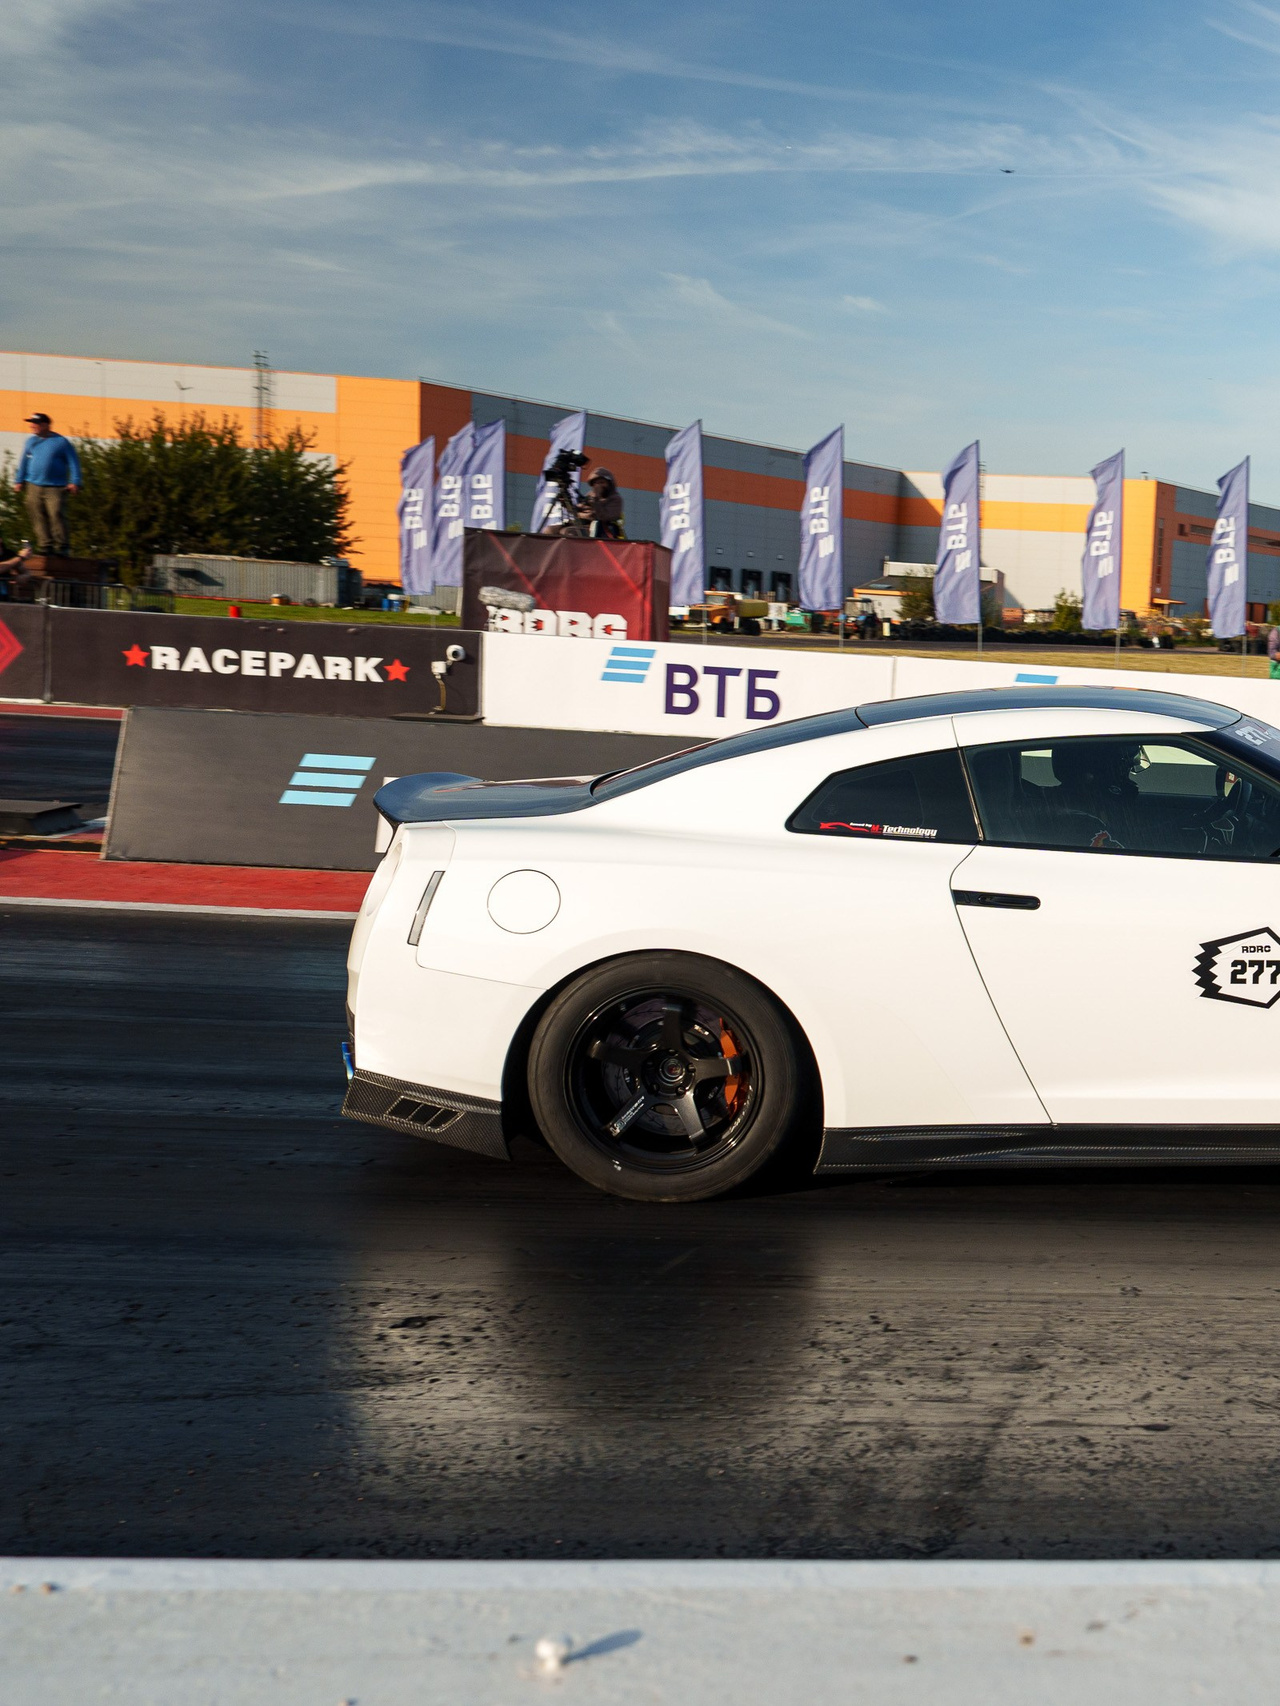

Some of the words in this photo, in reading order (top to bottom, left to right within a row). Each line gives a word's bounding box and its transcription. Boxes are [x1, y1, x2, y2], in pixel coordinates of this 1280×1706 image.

[150, 645, 384, 683] RACEPARK
[664, 663, 782, 721] ВТБ
[871, 824, 938, 837] M-Technology
[1241, 944, 1272, 954] RDRC
